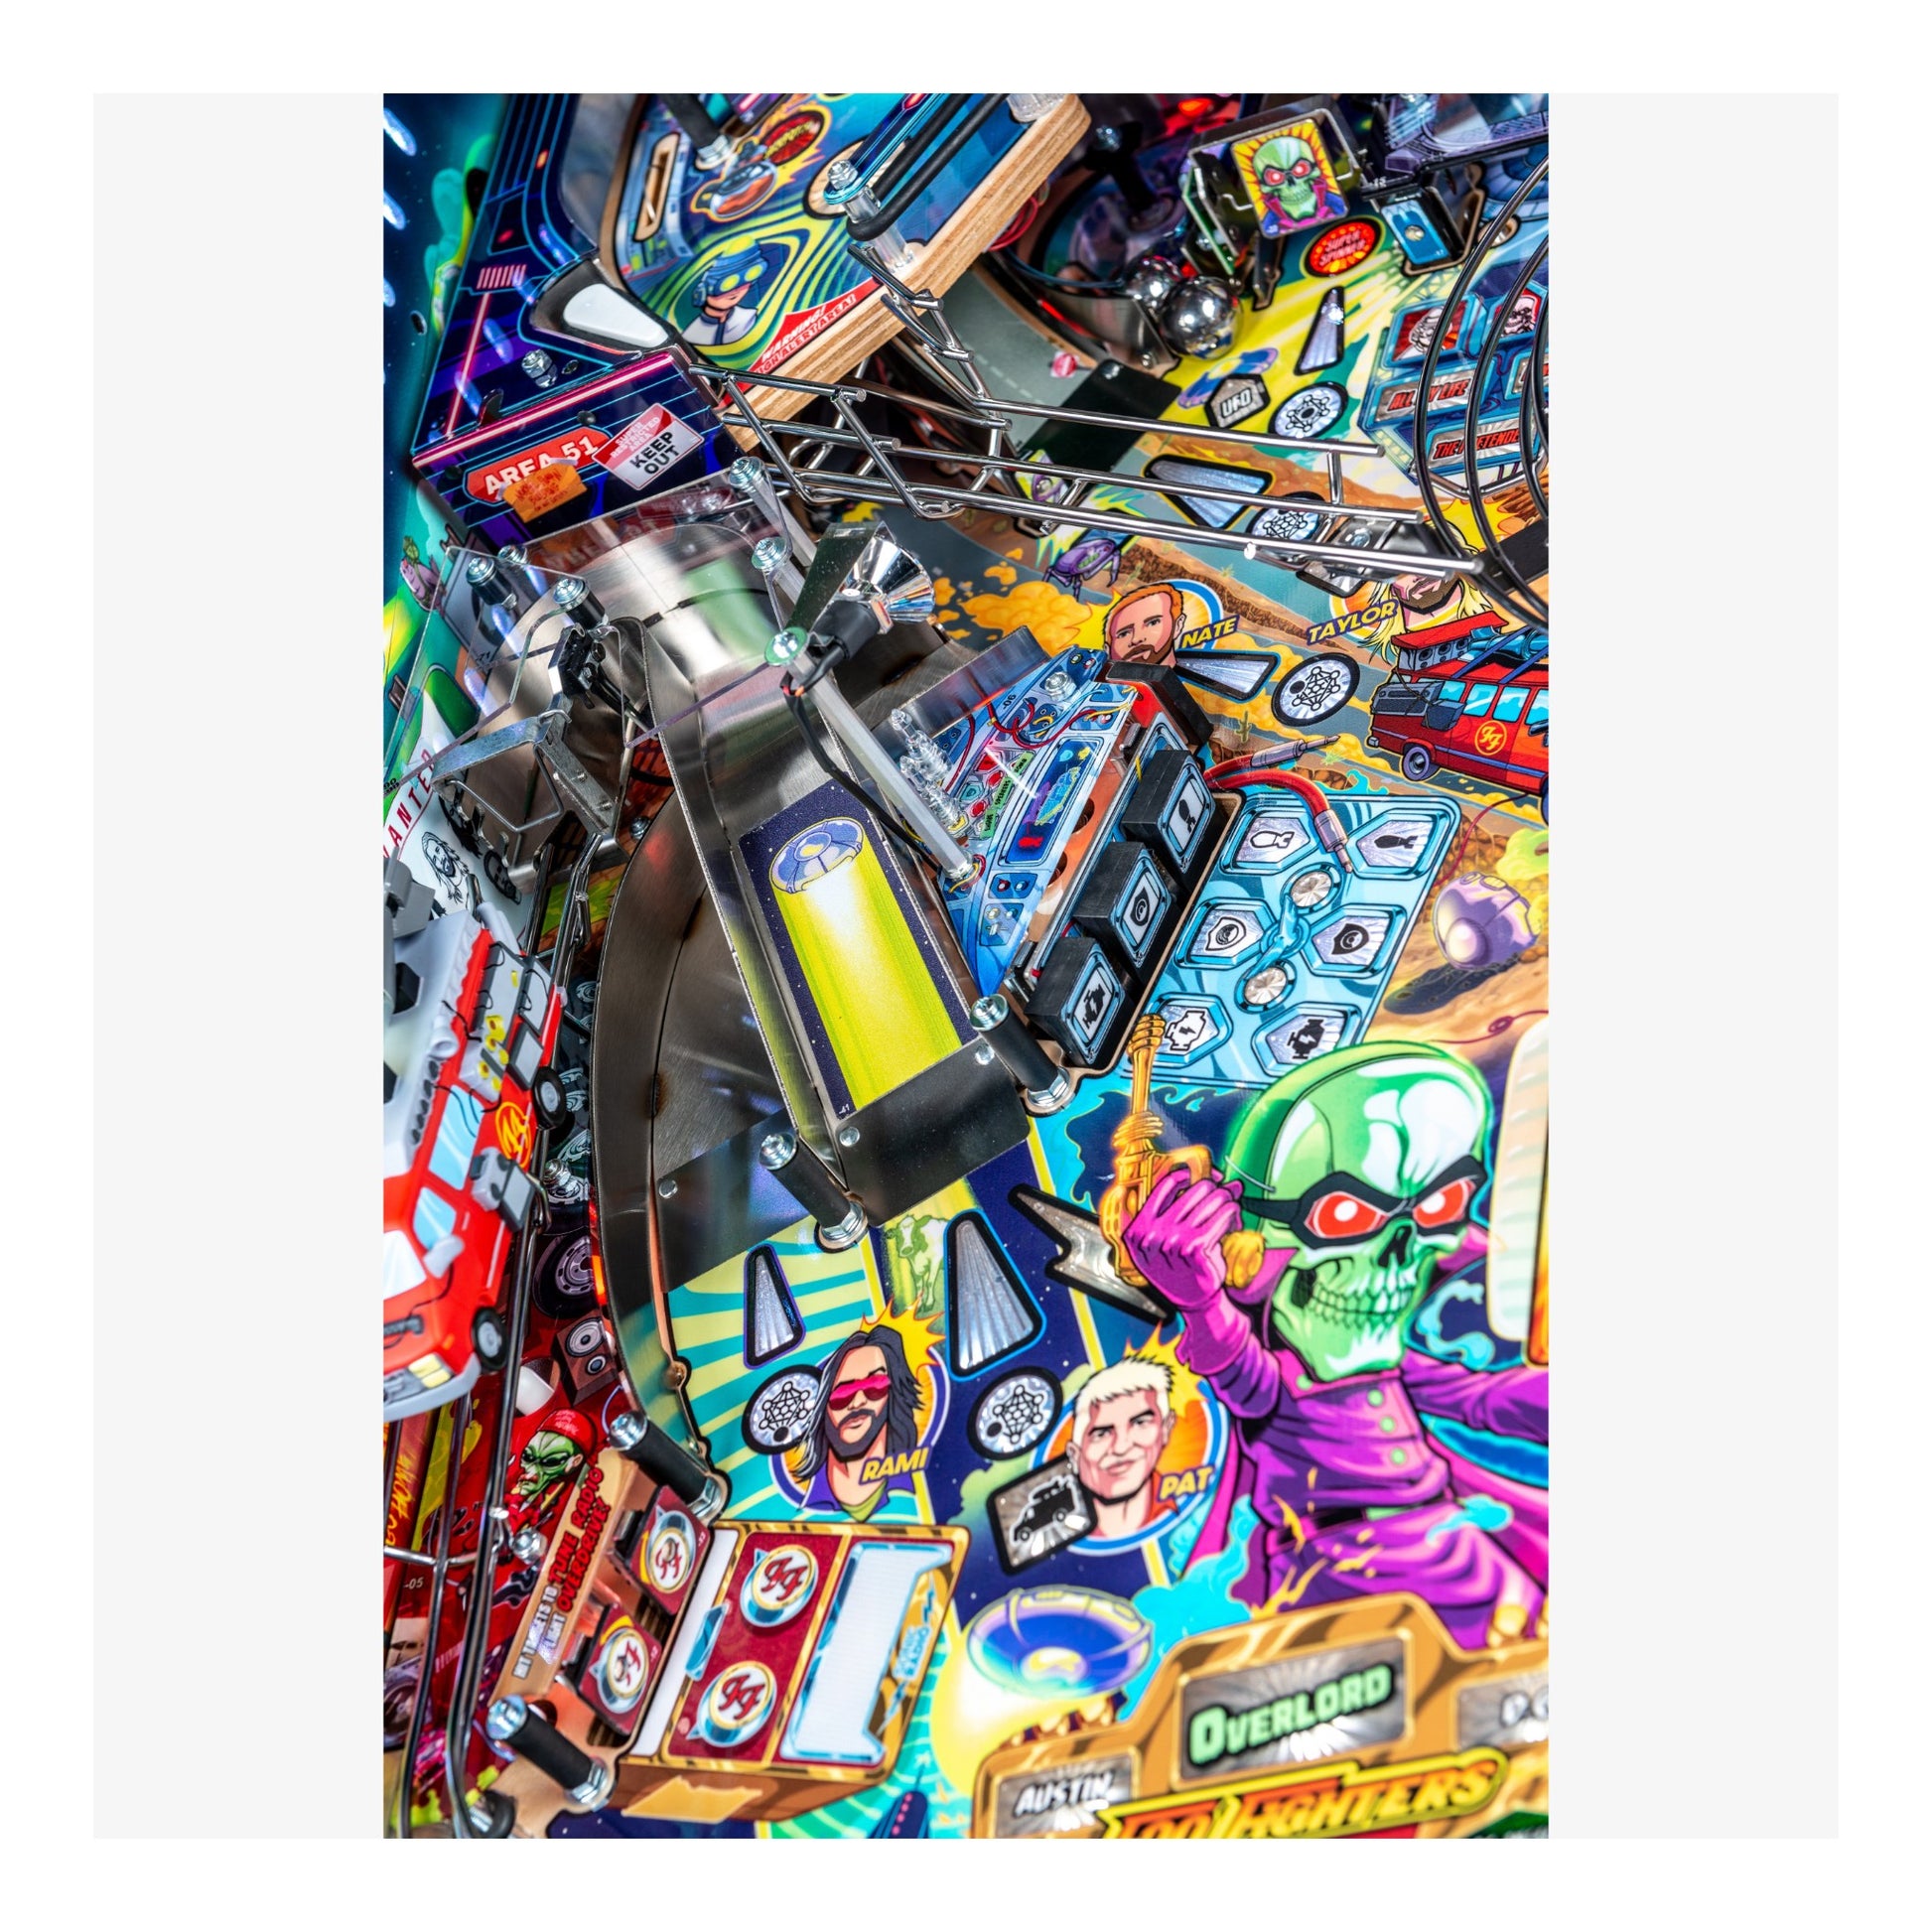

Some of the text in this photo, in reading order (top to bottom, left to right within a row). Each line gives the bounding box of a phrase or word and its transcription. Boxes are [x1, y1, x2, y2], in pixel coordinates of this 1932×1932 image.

[778, 323, 818, 358] ALERT
[817, 293, 857, 332] AREA!
[1220, 387, 1252, 419] UFO
[1387, 390, 1416, 411] ALL
[1438, 378, 1471, 401] LIFE
[609, 416, 661, 459] RESTRICTED
[616, 421, 647, 445] SUPER
[628, 433, 653, 455] AREA
[629, 431, 674, 470] KEEP
[1433, 428, 1520, 460] THE ETENDE
[484, 453, 554, 495] AREA
[561, 435, 599, 463] 51
[643, 445, 680, 476] OUT
[1180, 617, 1238, 649] NATE
[1308, 600, 1397, 643] TAYLOR
[382, 748, 437, 860] ANTED
[862, 1447, 930, 1483] RAMI
[1159, 1465, 1214, 1501] PAT
[548, 1530, 580, 1586] TUNE
[570, 1466, 605, 1530] RADIO
[556, 1494, 613, 1613] OVERDRIVE!
[404, 1576, 425, 1589] -05
[1188, 1664, 1393, 1766] OVERLORD
[1013, 1770, 1115, 1817] AUSTIN
[1232, 1757, 1498, 1839] FIGHTERS
